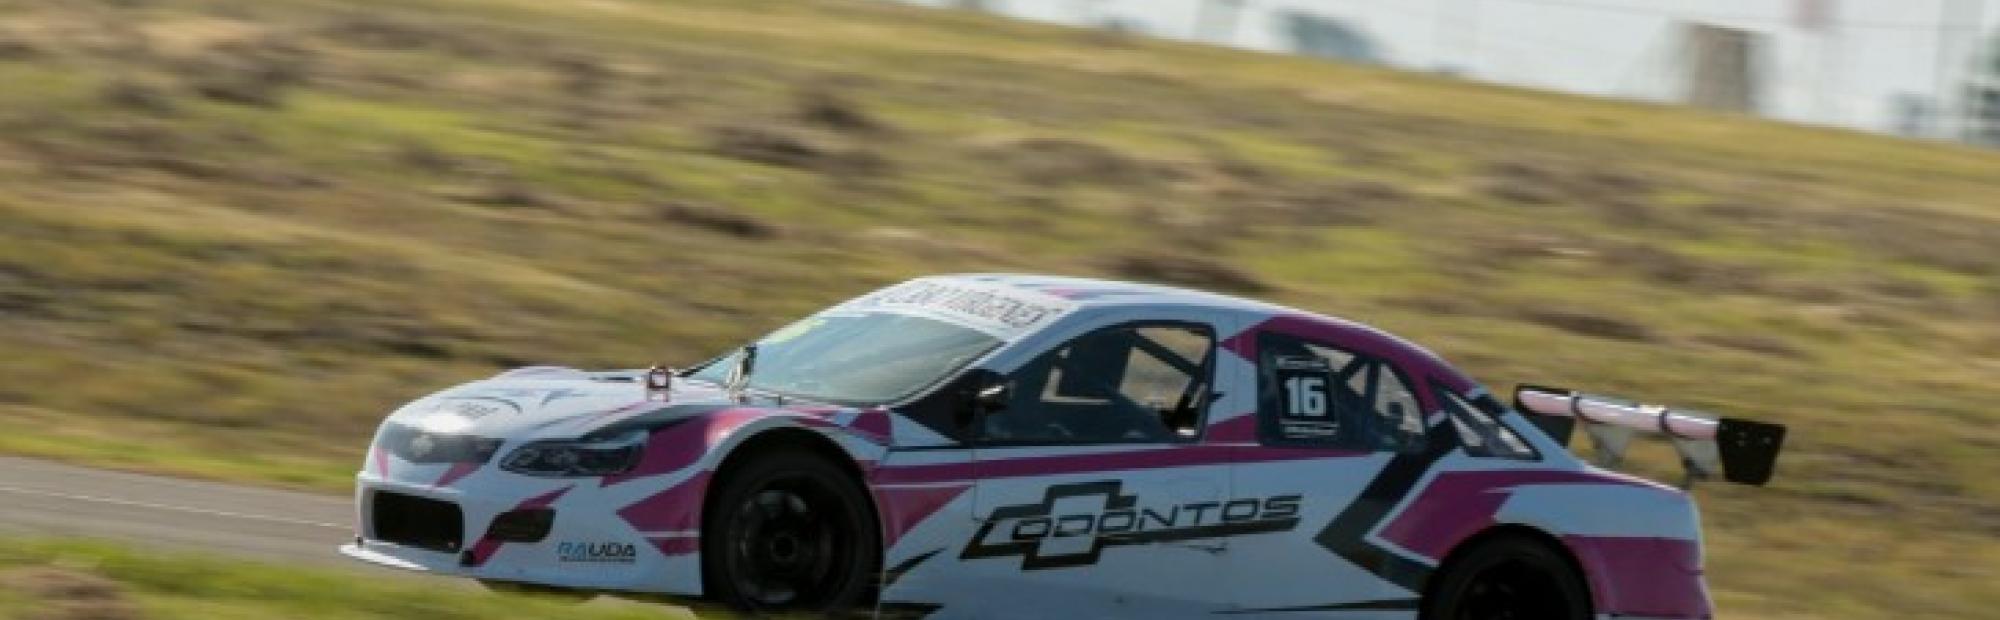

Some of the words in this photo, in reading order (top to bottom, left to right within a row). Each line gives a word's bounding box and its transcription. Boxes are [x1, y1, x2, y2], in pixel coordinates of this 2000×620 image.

[1285, 377, 1326, 416] 16
[1012, 494, 1303, 541] ODONTOS
[557, 541, 636, 559] RAUDA
